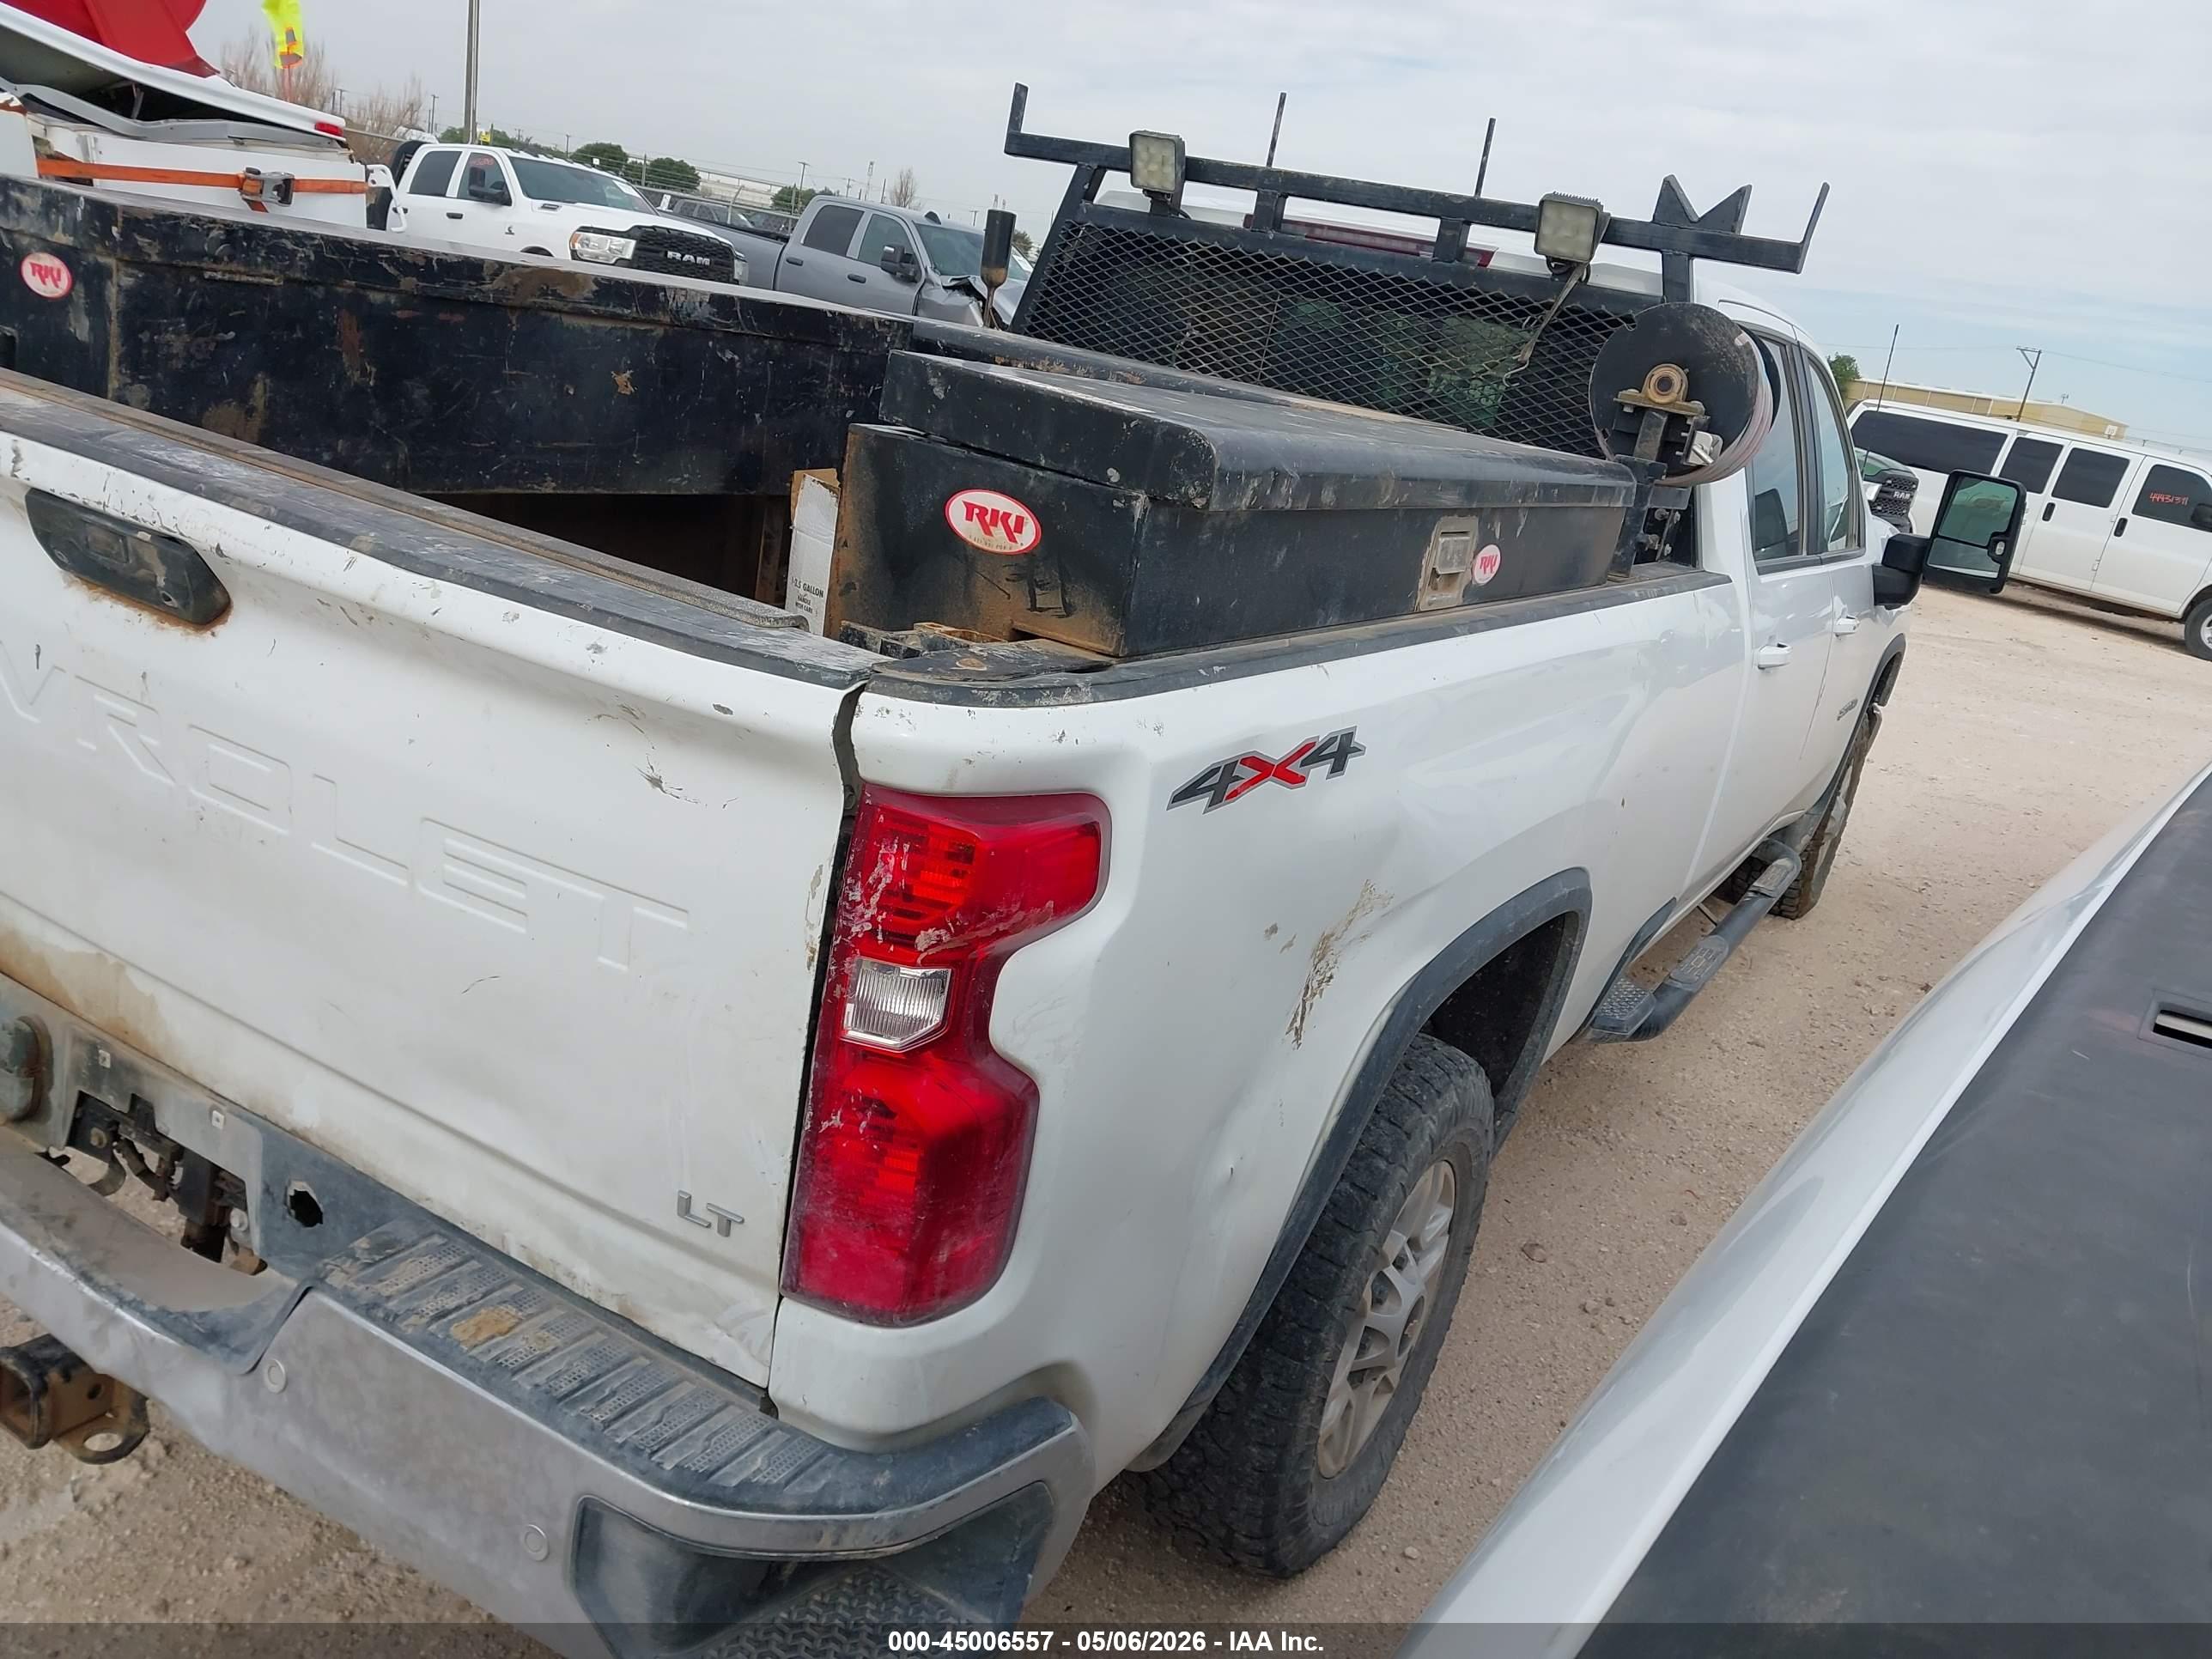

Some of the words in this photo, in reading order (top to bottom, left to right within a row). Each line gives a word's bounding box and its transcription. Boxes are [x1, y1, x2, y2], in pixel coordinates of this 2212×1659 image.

[666, 250, 711, 266] RAM
[1893, 490, 1911, 500] RAM
[961, 500, 1025, 544] RKI
[803, 583, 824, 598] GALLON
[1167, 726, 1365, 812] 4X4
[677, 1189, 744, 1237] LT
